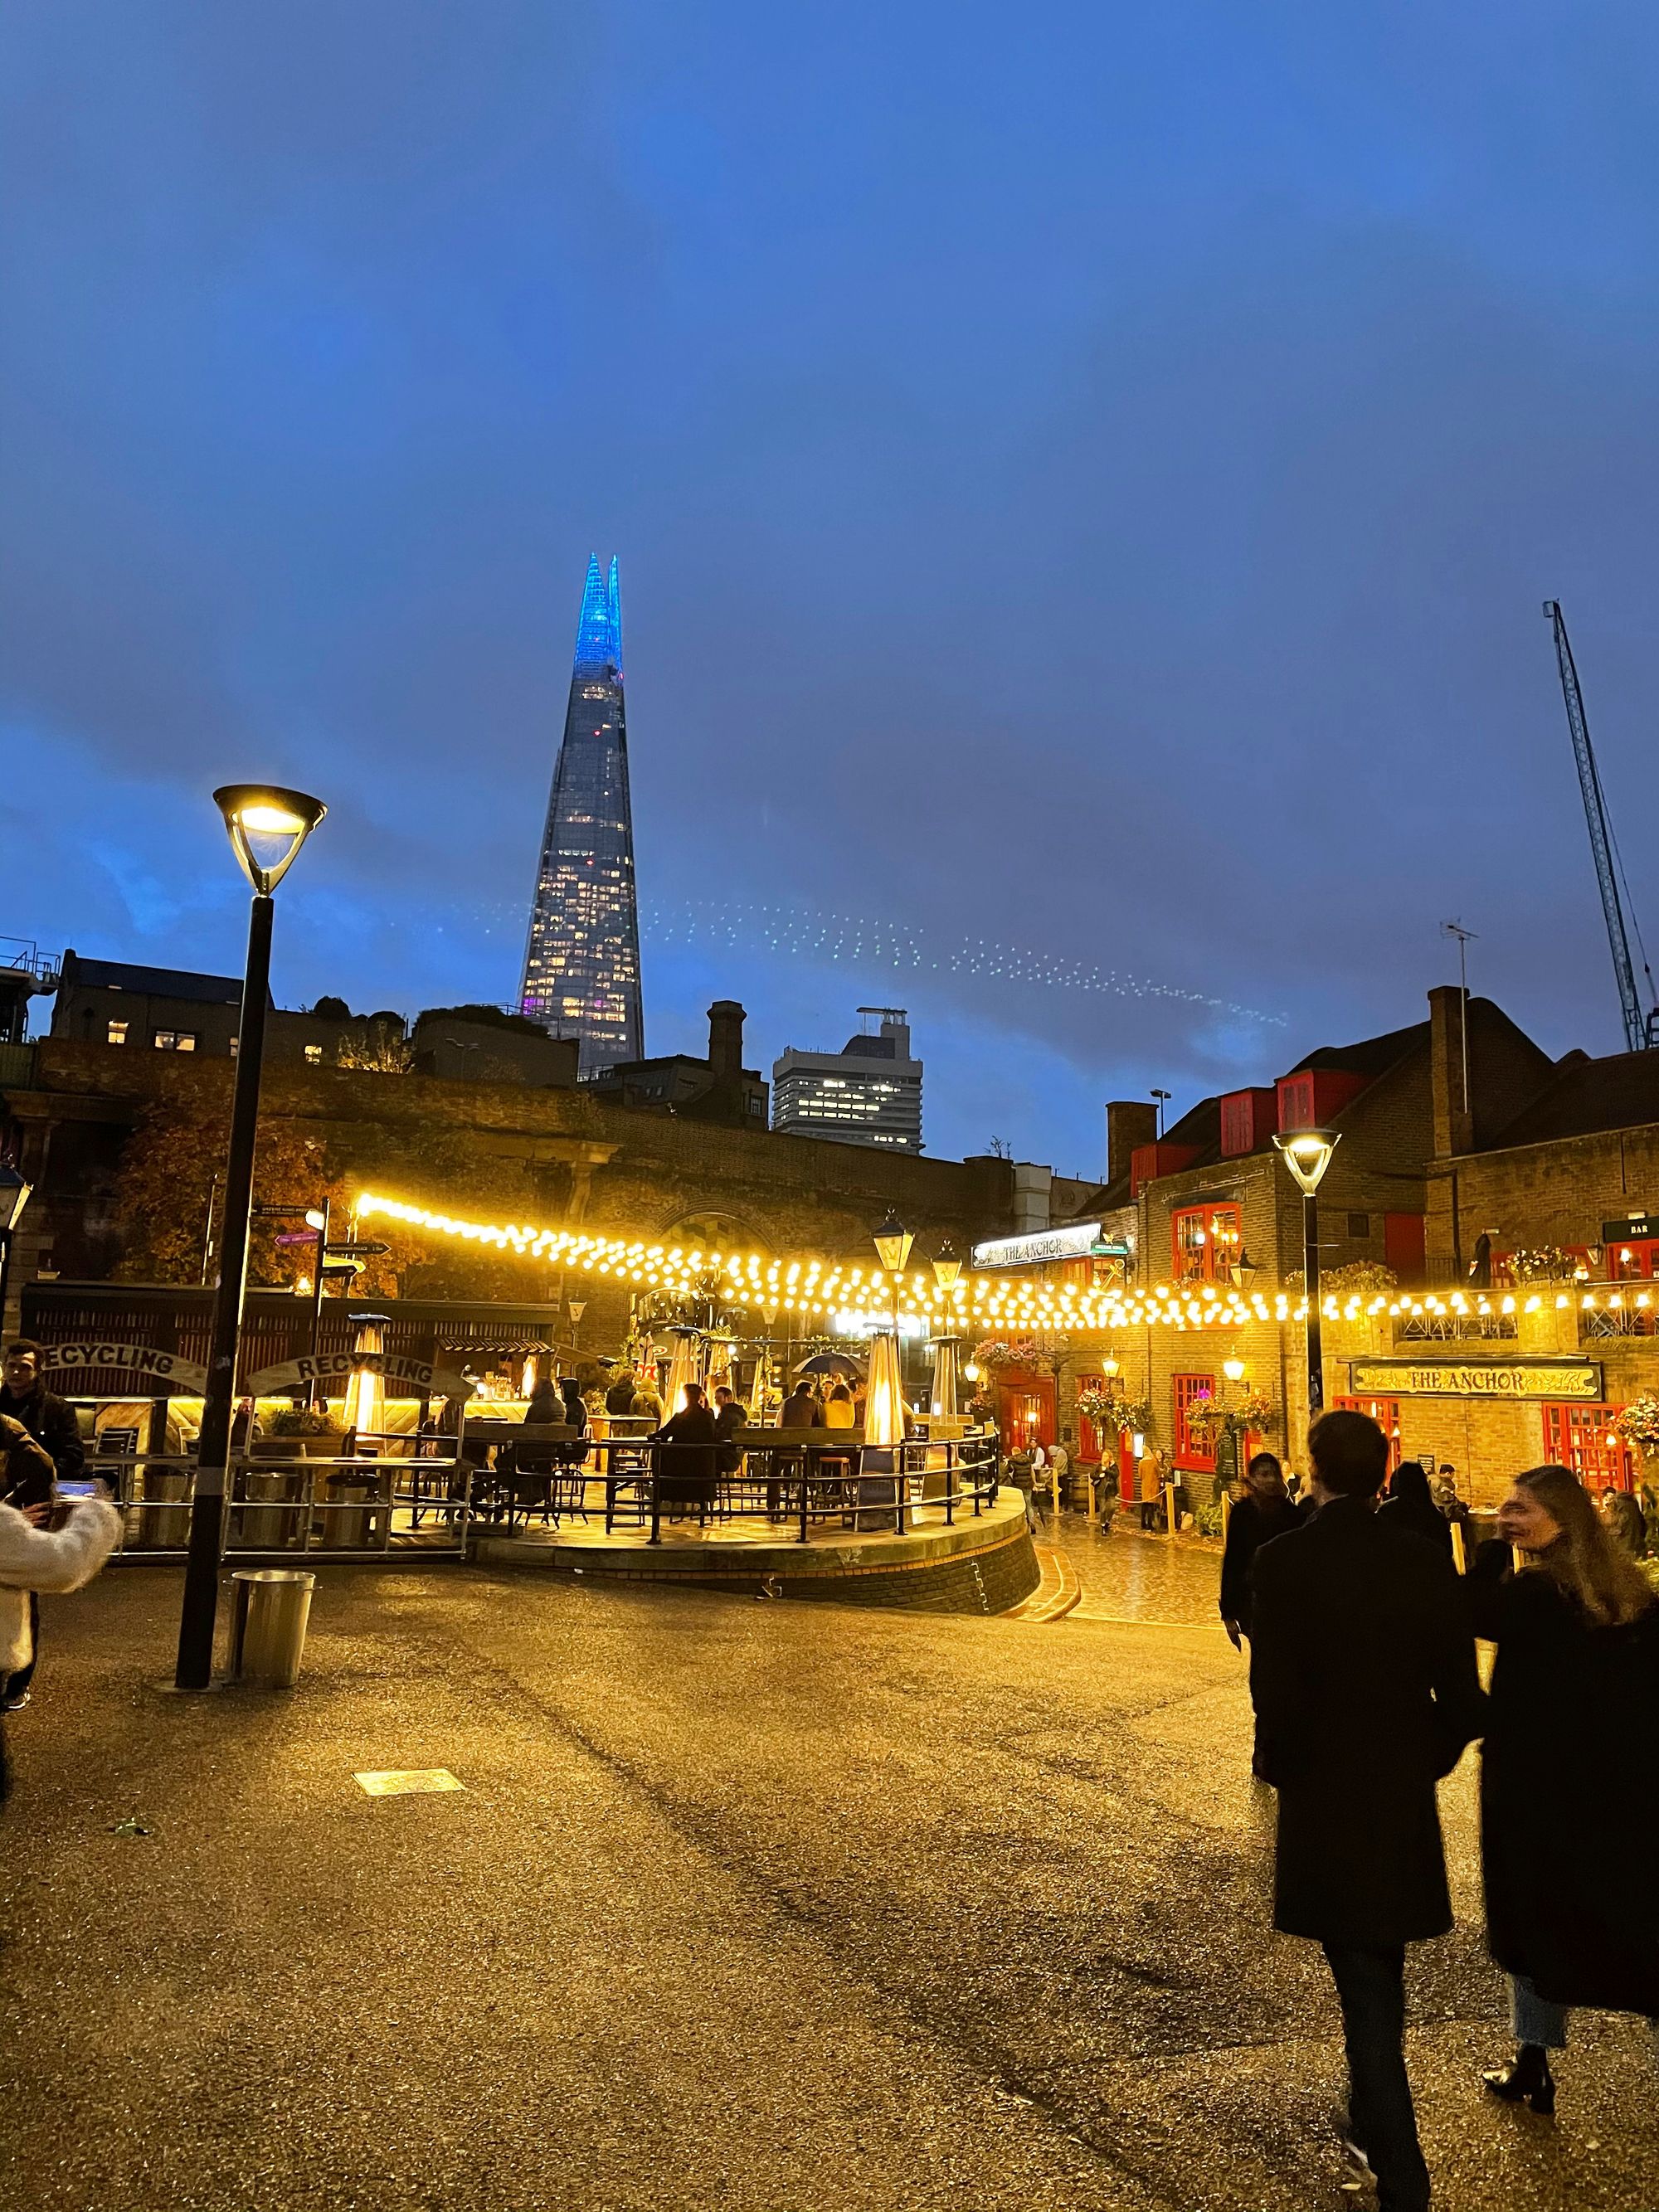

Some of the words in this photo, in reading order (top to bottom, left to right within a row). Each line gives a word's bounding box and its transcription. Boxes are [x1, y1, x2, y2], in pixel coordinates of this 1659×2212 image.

[1631, 1225, 1648, 1234] BAR
[1003, 1245, 1021, 1261] THE
[1024, 1238, 1063, 1257] ANCHOR
[43, 1344, 173, 1374] ECYCLING
[297, 1354, 433, 1383] RECYCLING
[1410, 1371, 1442, 1388] THE
[1448, 1370, 1525, 1391] ANCHOR
